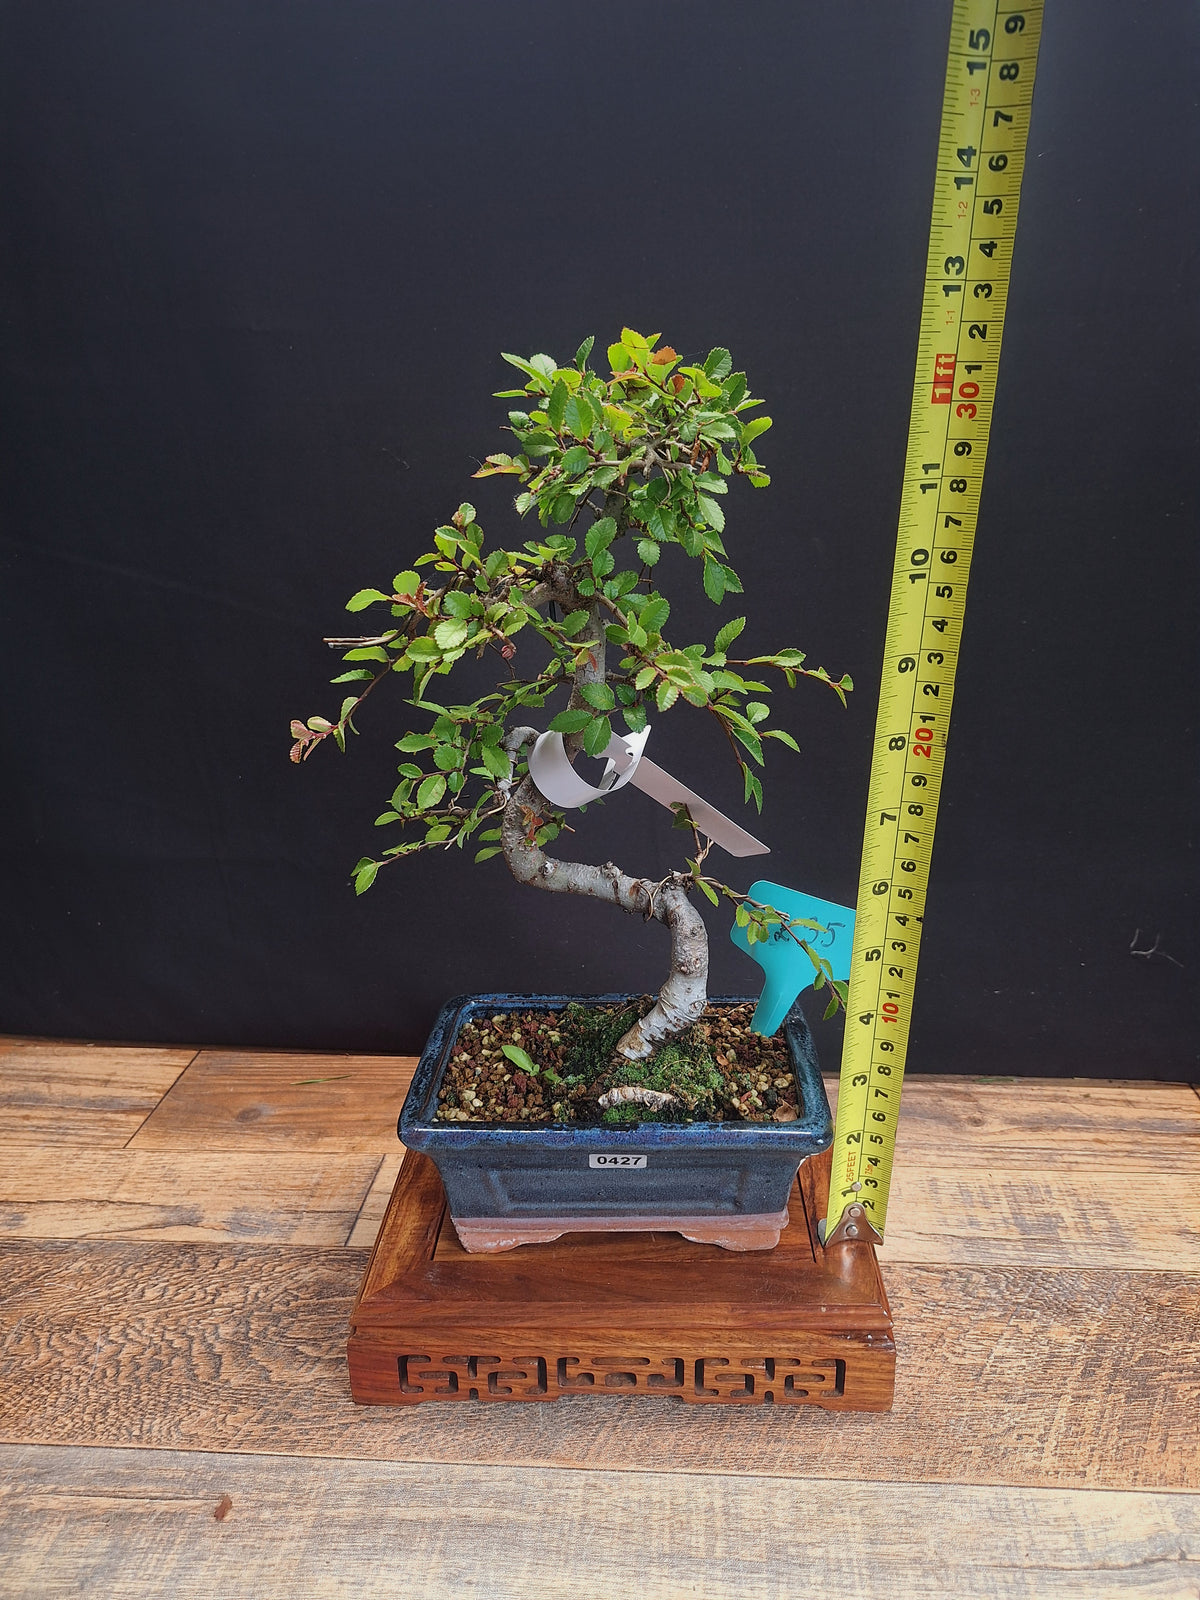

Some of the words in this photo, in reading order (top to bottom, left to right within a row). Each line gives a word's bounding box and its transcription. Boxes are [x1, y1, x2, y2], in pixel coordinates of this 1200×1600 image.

[1005, 15, 1025, 33] 9
[967, 28, 991, 76] 15
[999, 62, 1019, 81] 8
[970, 88, 981, 106] 1-3
[993, 110, 1013, 127] 7
[954, 145, 977, 190] 14
[988, 154, 1008, 172] 6
[957, 201, 968, 219] 1-2
[983, 199, 1003, 215] 5
[979, 241, 998, 258] 4
[942, 256, 965, 297] 13
[973, 283, 993, 299] 3
[945, 310, 956, 325] 1-1
[968, 324, 987, 340] 2
[936, 355, 956, 377] ft
[964, 364, 982, 375] 1
[934, 387, 951, 399] 1
[956, 382, 980, 419] 30
[953, 441, 972, 457] 9
[919, 463, 941, 494] 11
[949, 478, 967, 493] 8
[944, 515, 962, 528] 7
[940, 550, 958, 564] 6
[909, 548, 929, 584] 10
[935, 585, 953, 599] 5
[931, 619, 948, 633] 4
[898, 657, 916, 673] 9
[927, 652, 944, 665] 3
[923, 684, 940, 697] 2
[919, 714, 936, 724] 1
[889, 736, 906, 751] 8
[912, 727, 934, 758] 20
[911, 775, 928, 787] 9
[907, 804, 924, 817] 8
[880, 812, 897, 826] 7
[904, 832, 920, 844] 7
[901, 860, 917, 873] 6
[872, 881, 889, 896] 6
[898, 888, 913, 900] 5
[894, 915, 909, 927] 4
[891, 941, 907, 953] 3
[865, 948, 882, 962] 5
[888, 966, 904, 979] 2
[886, 991, 900, 999] 1
[859, 1012, 875, 1026] 4
[881, 1002, 899, 1024] 10
[880, 1041, 895, 1052] 9
[877, 1065, 892, 1077] 8
[852, 1074, 867, 1087] 3
[874, 1089, 889, 1099] 7
[872, 1111, 886, 1123] 6
[846, 1132, 861, 1145] 2
[870, 1134, 884, 1145] 5
[596, 1156, 642, 1166] 0427
[867, 1157, 881, 1167] 4
[864, 1178, 879, 1189] 3
[862, 1200, 875, 1210] 2
